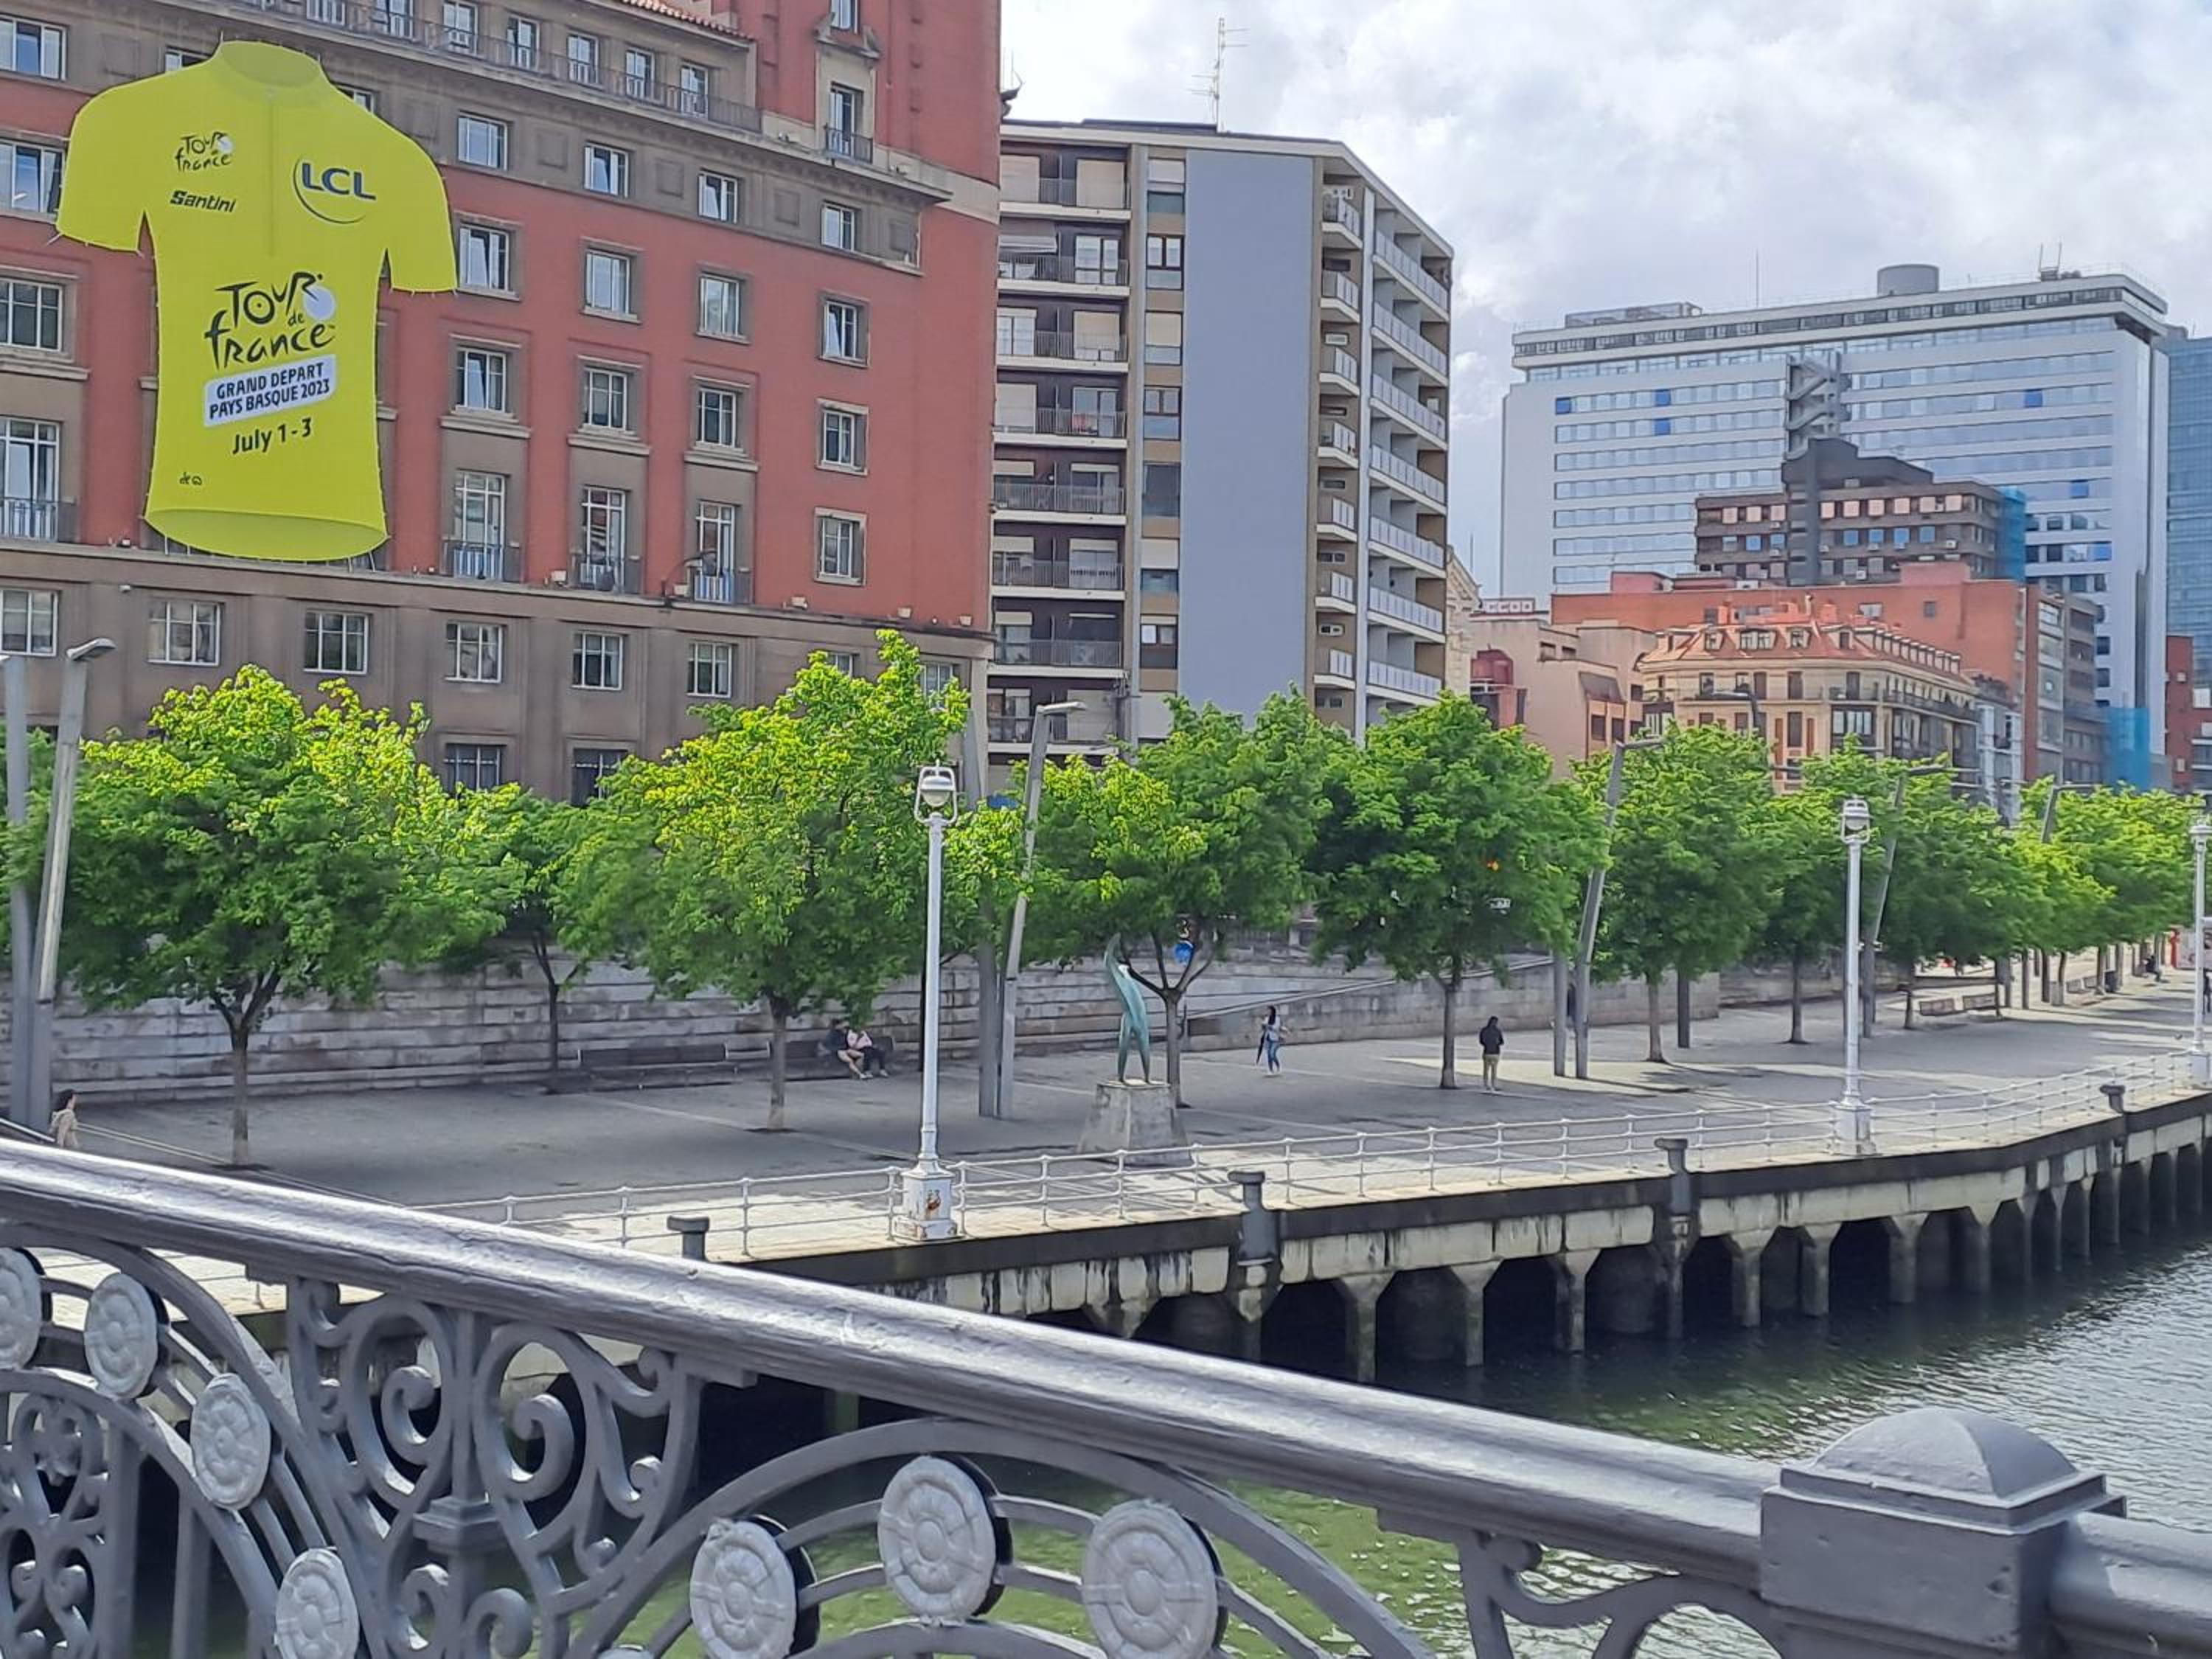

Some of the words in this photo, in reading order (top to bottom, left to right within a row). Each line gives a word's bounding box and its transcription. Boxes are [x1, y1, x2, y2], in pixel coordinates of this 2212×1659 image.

[302, 162, 377, 201] LCL
[170, 190, 236, 212] Santini
[288, 310, 305, 327] de
[216, 375, 266, 400] GRAND
[271, 362, 324, 387] DEPART
[209, 399, 243, 420] PAYS
[246, 385, 299, 411] BASQUE
[301, 378, 330, 399] 2023
[232, 428, 273, 454] July
